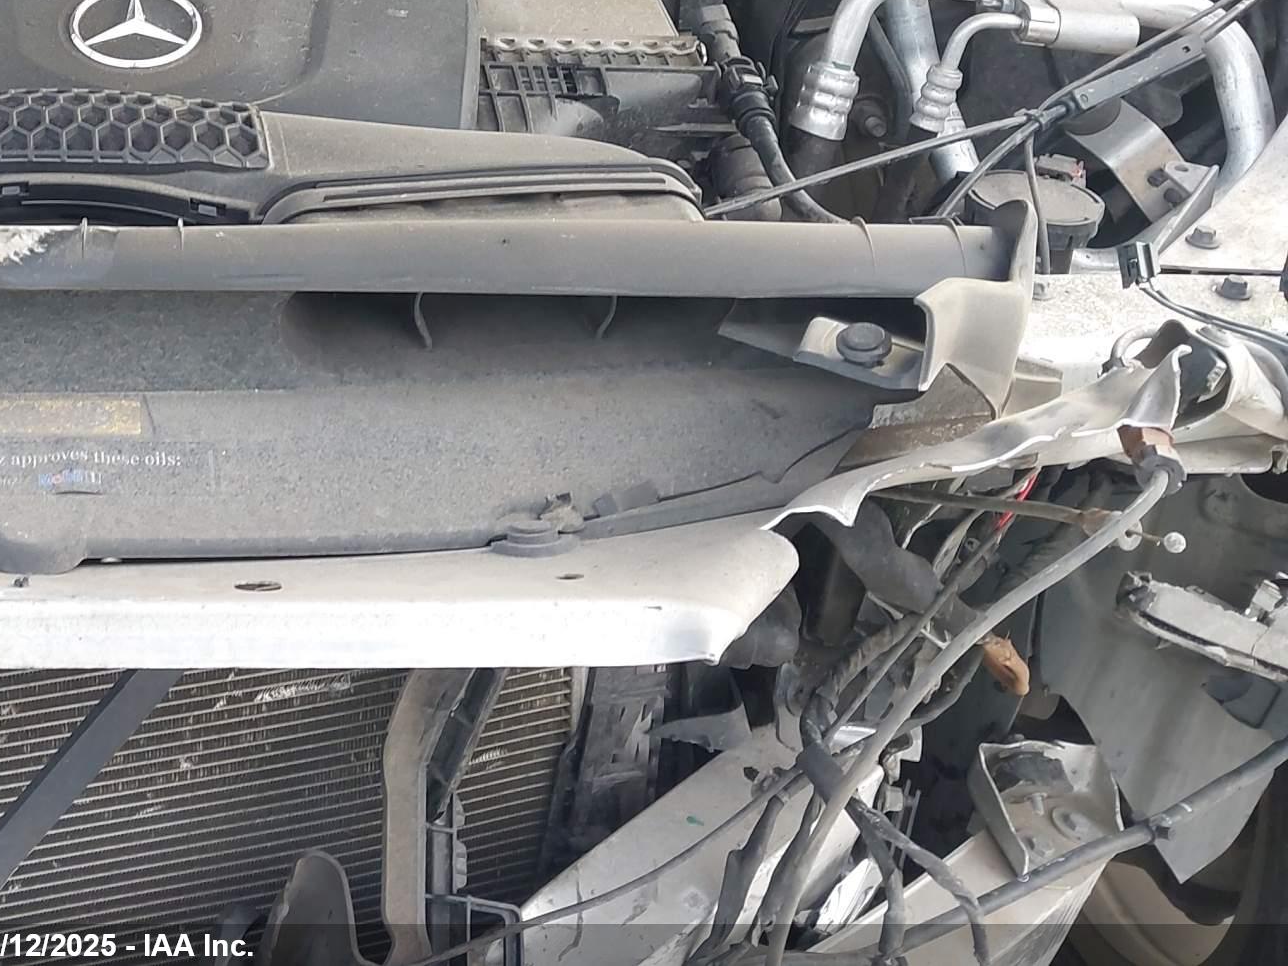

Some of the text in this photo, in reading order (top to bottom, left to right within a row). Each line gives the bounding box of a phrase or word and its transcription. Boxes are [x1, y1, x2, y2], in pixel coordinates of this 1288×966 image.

[11, 449, 89, 469] approves
[94, 450, 140, 466] these
[144, 451, 182, 467] oils:
